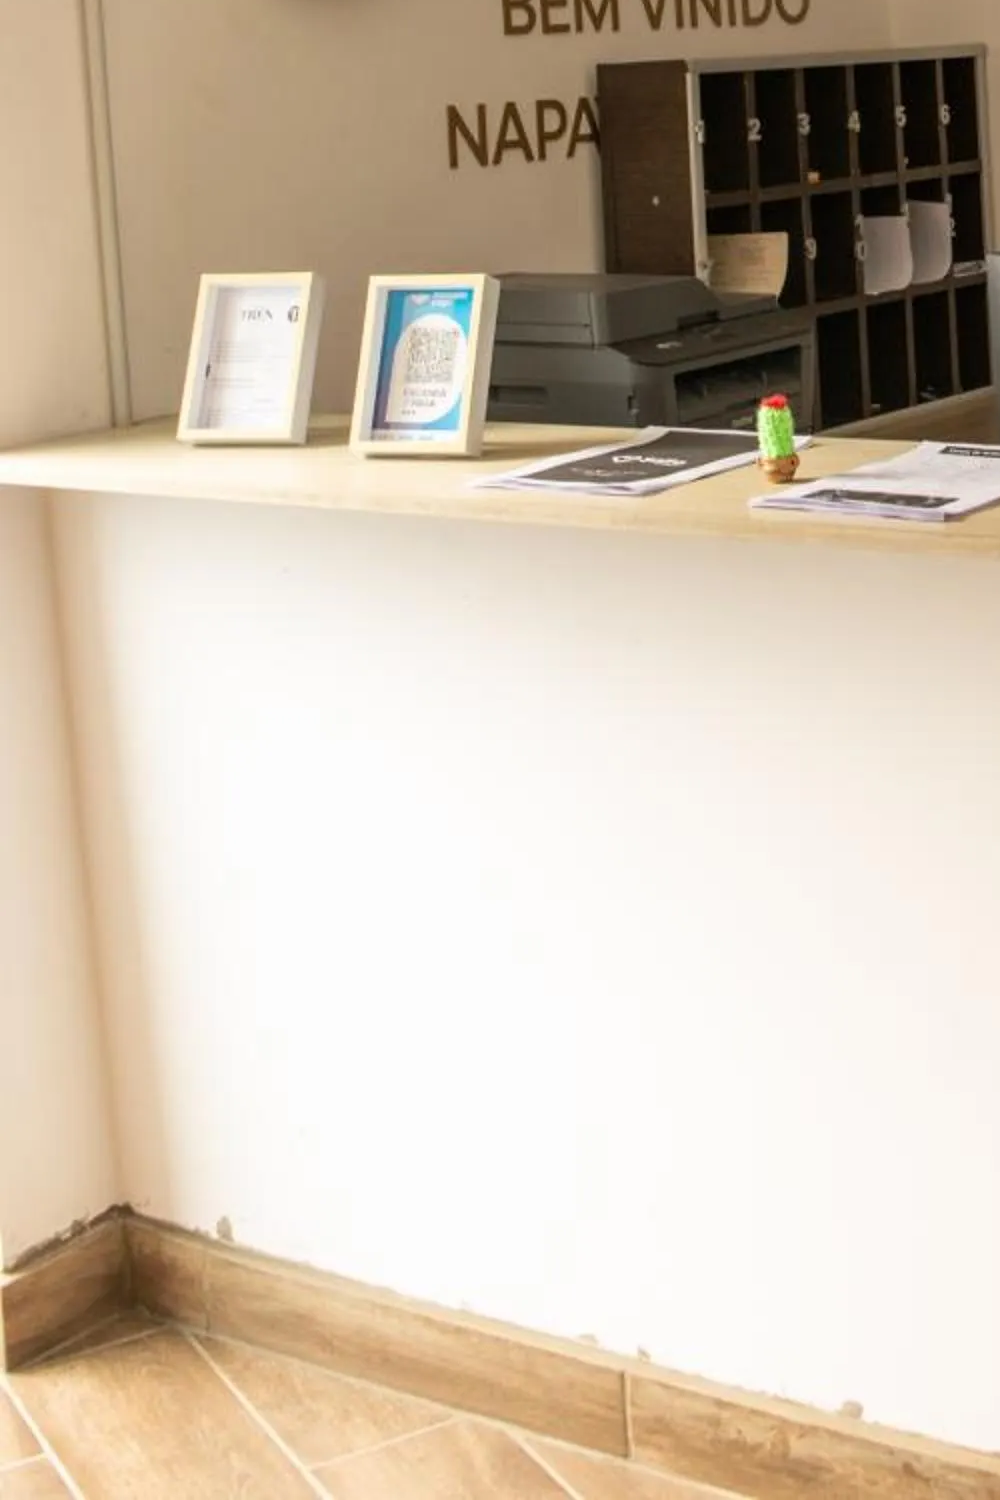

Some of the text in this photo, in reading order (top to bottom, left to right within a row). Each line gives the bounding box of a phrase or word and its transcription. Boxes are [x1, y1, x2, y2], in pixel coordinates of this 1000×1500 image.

[797, 112, 811, 136] 3
[847, 110, 861, 133] 4
[895, 105, 907, 128] 5
[941, 103, 951, 125] 6
[446, 95, 601, 169] NAPA
[747, 118, 762, 141] 2
[804, 237, 817, 260] 9
